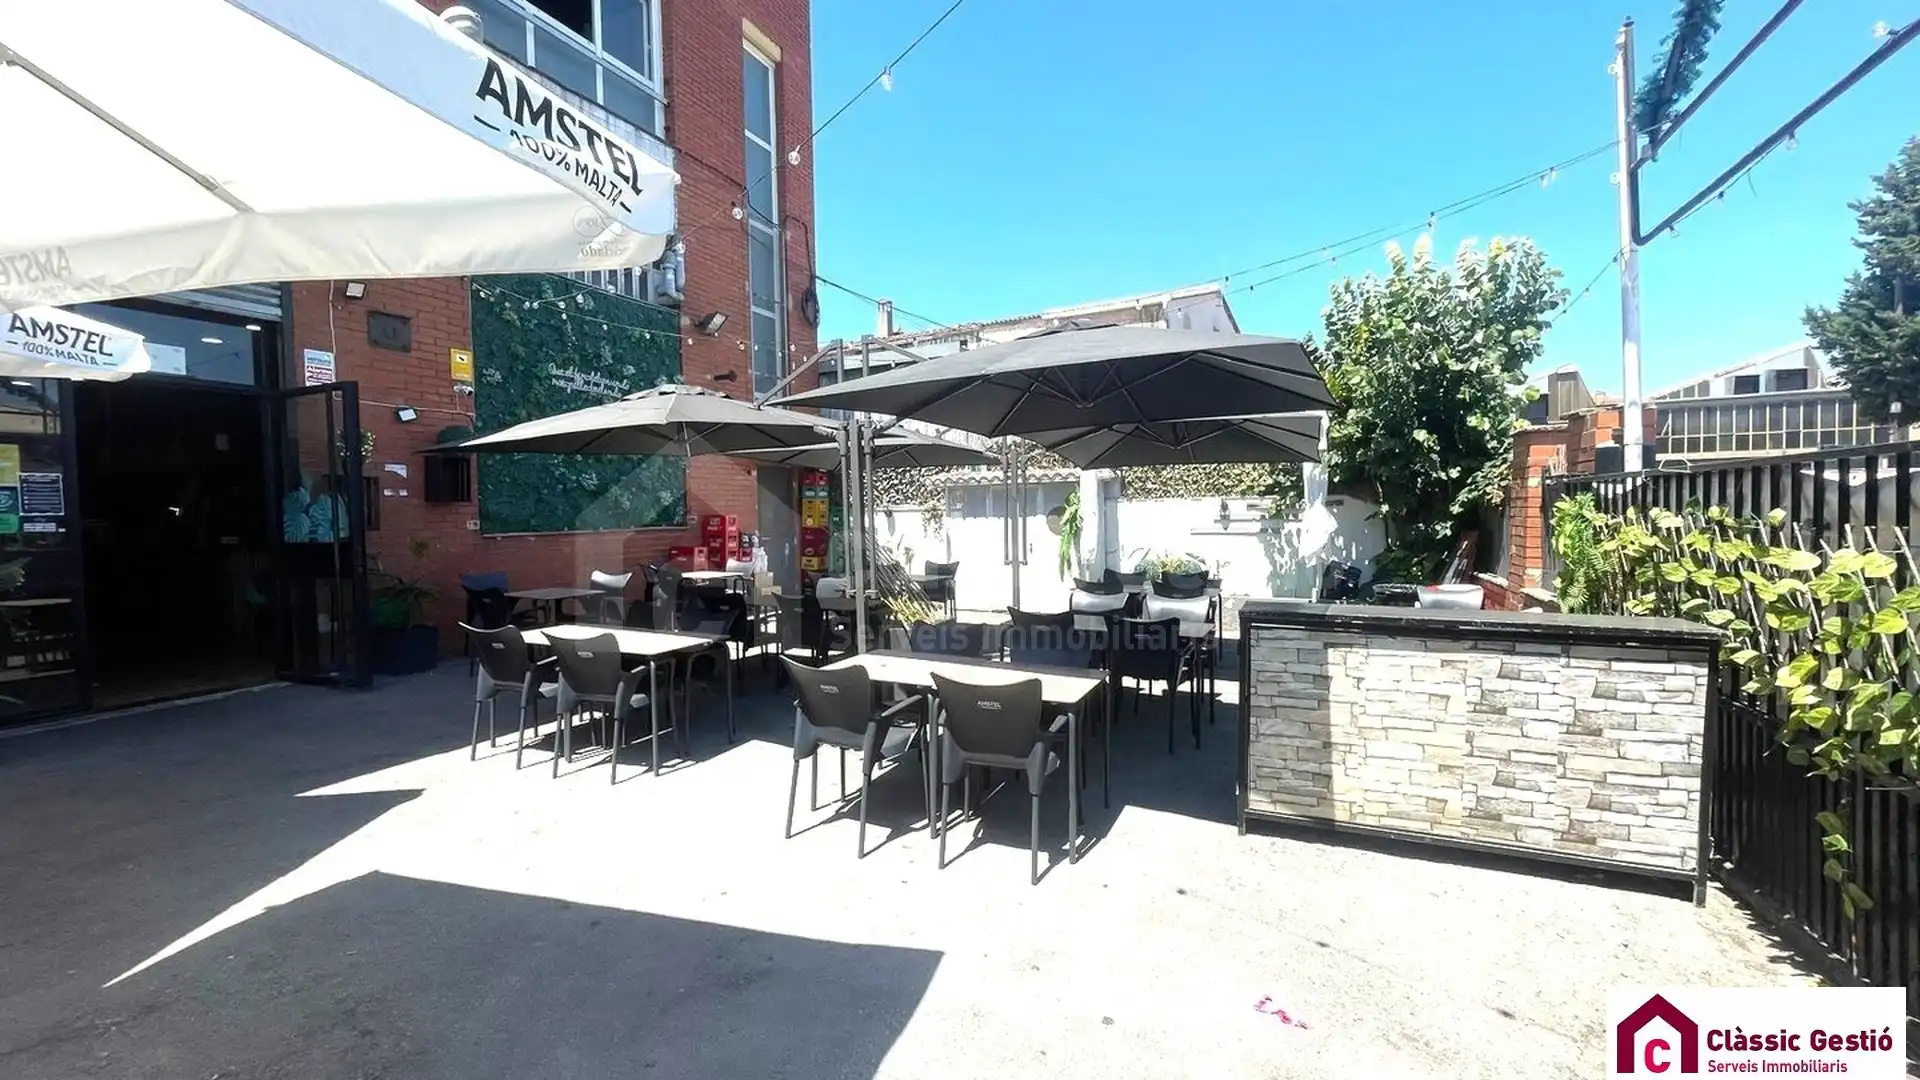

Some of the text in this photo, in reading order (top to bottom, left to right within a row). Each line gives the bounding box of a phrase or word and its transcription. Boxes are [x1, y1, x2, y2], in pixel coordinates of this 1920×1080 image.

[476, 57, 643, 196] AMSTEL
[510, 129, 624, 207] 100% MALTA
[8, 313, 113, 357] AMSTEL
[22, 340, 100, 366] 100% MALTA
